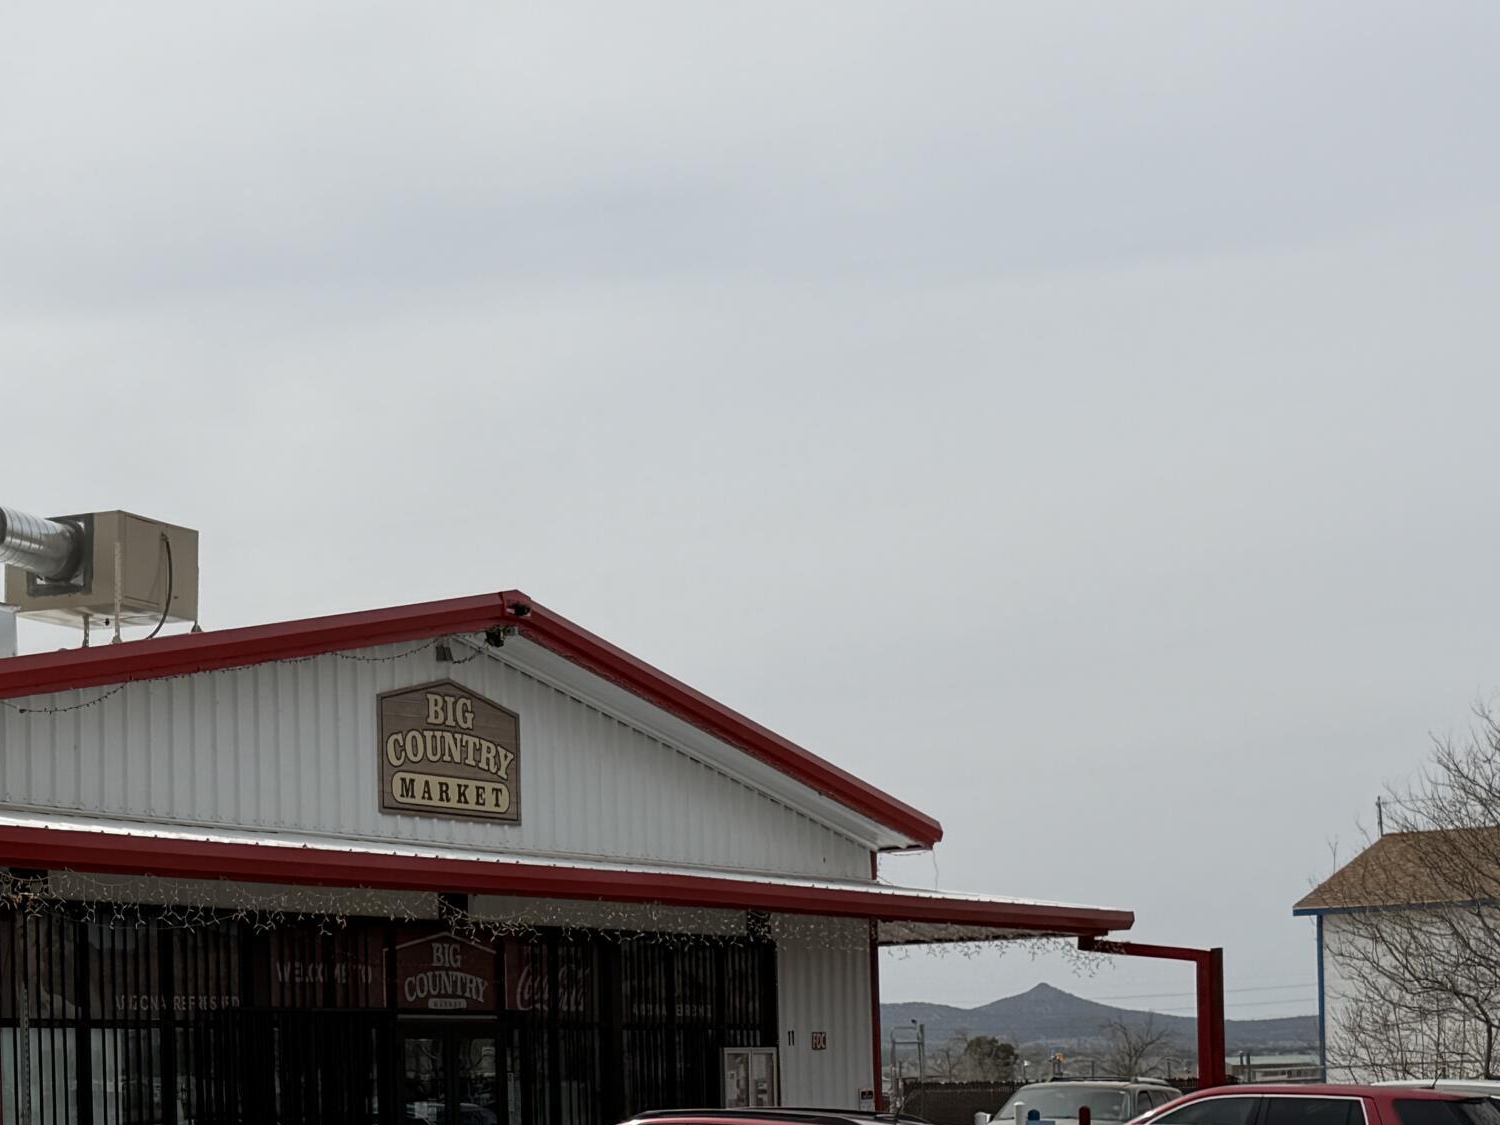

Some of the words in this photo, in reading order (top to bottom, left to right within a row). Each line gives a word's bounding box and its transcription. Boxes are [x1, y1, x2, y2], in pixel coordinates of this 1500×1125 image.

[426, 693, 474, 730] BIG
[386, 730, 515, 779] COUNTRY
[399, 776, 503, 808] MARKET
[430, 943, 462, 967] BIG
[404, 971, 488, 1003] COUNTRY
